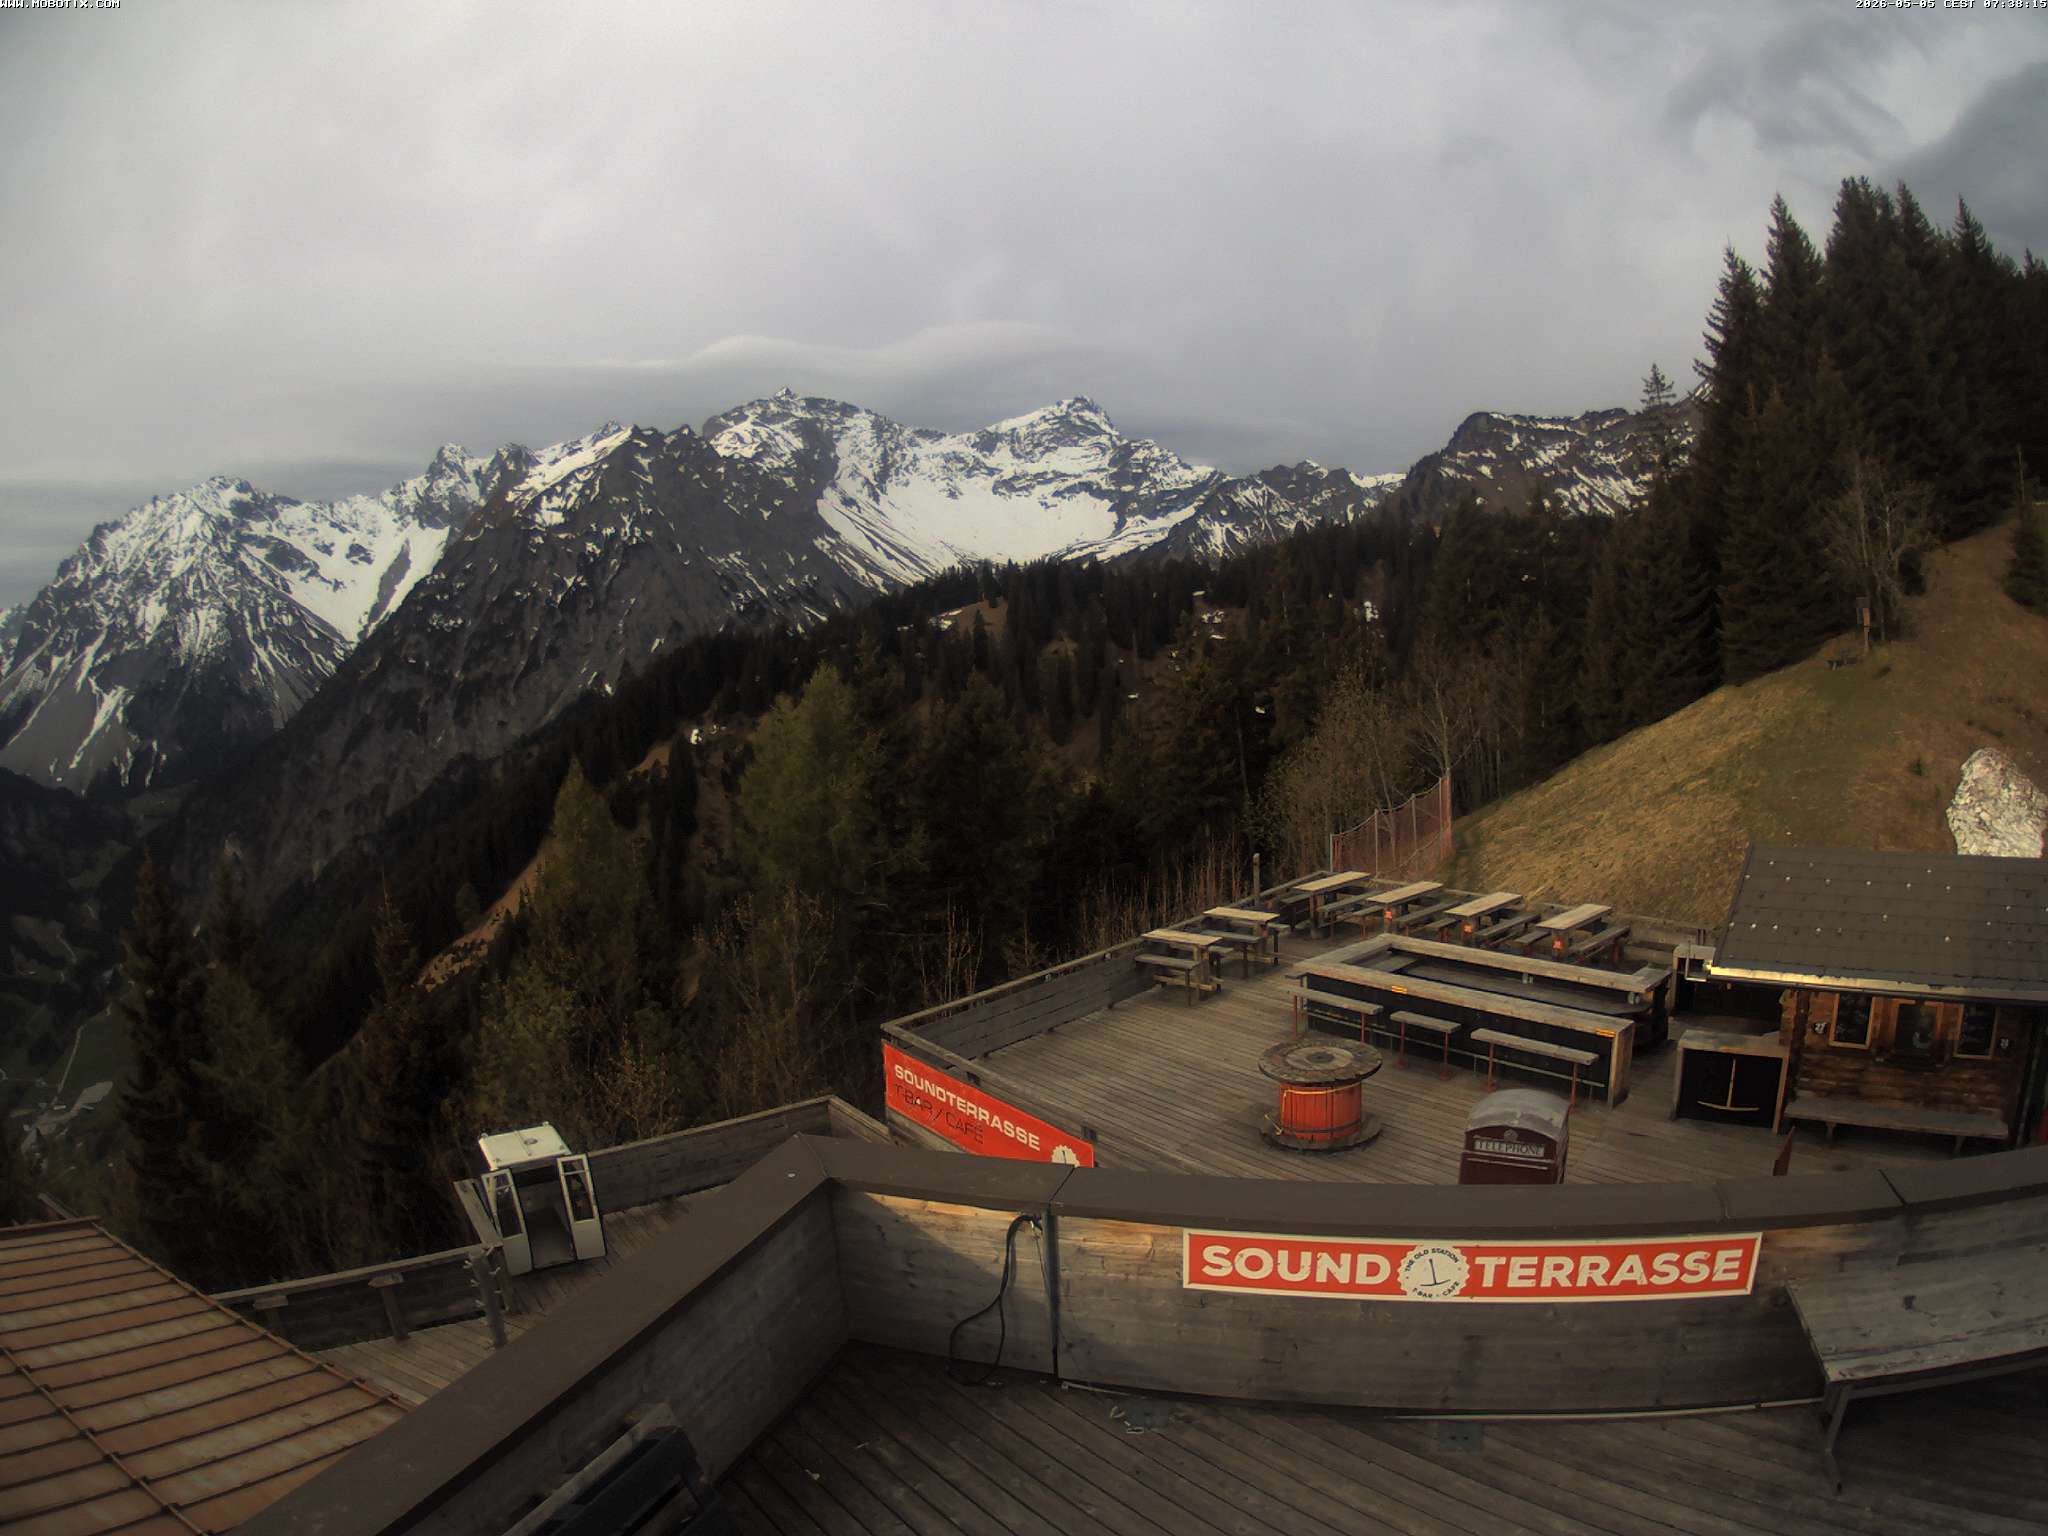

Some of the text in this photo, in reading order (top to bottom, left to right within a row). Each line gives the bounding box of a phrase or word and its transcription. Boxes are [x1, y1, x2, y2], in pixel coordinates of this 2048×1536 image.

[894, 1064, 1041, 1151] SOUNDTERRASSE
[1201, 1244, 1743, 1288] SOUND TERRASSE
[1405, 1247, 1459, 1271] THE OLD STATION
